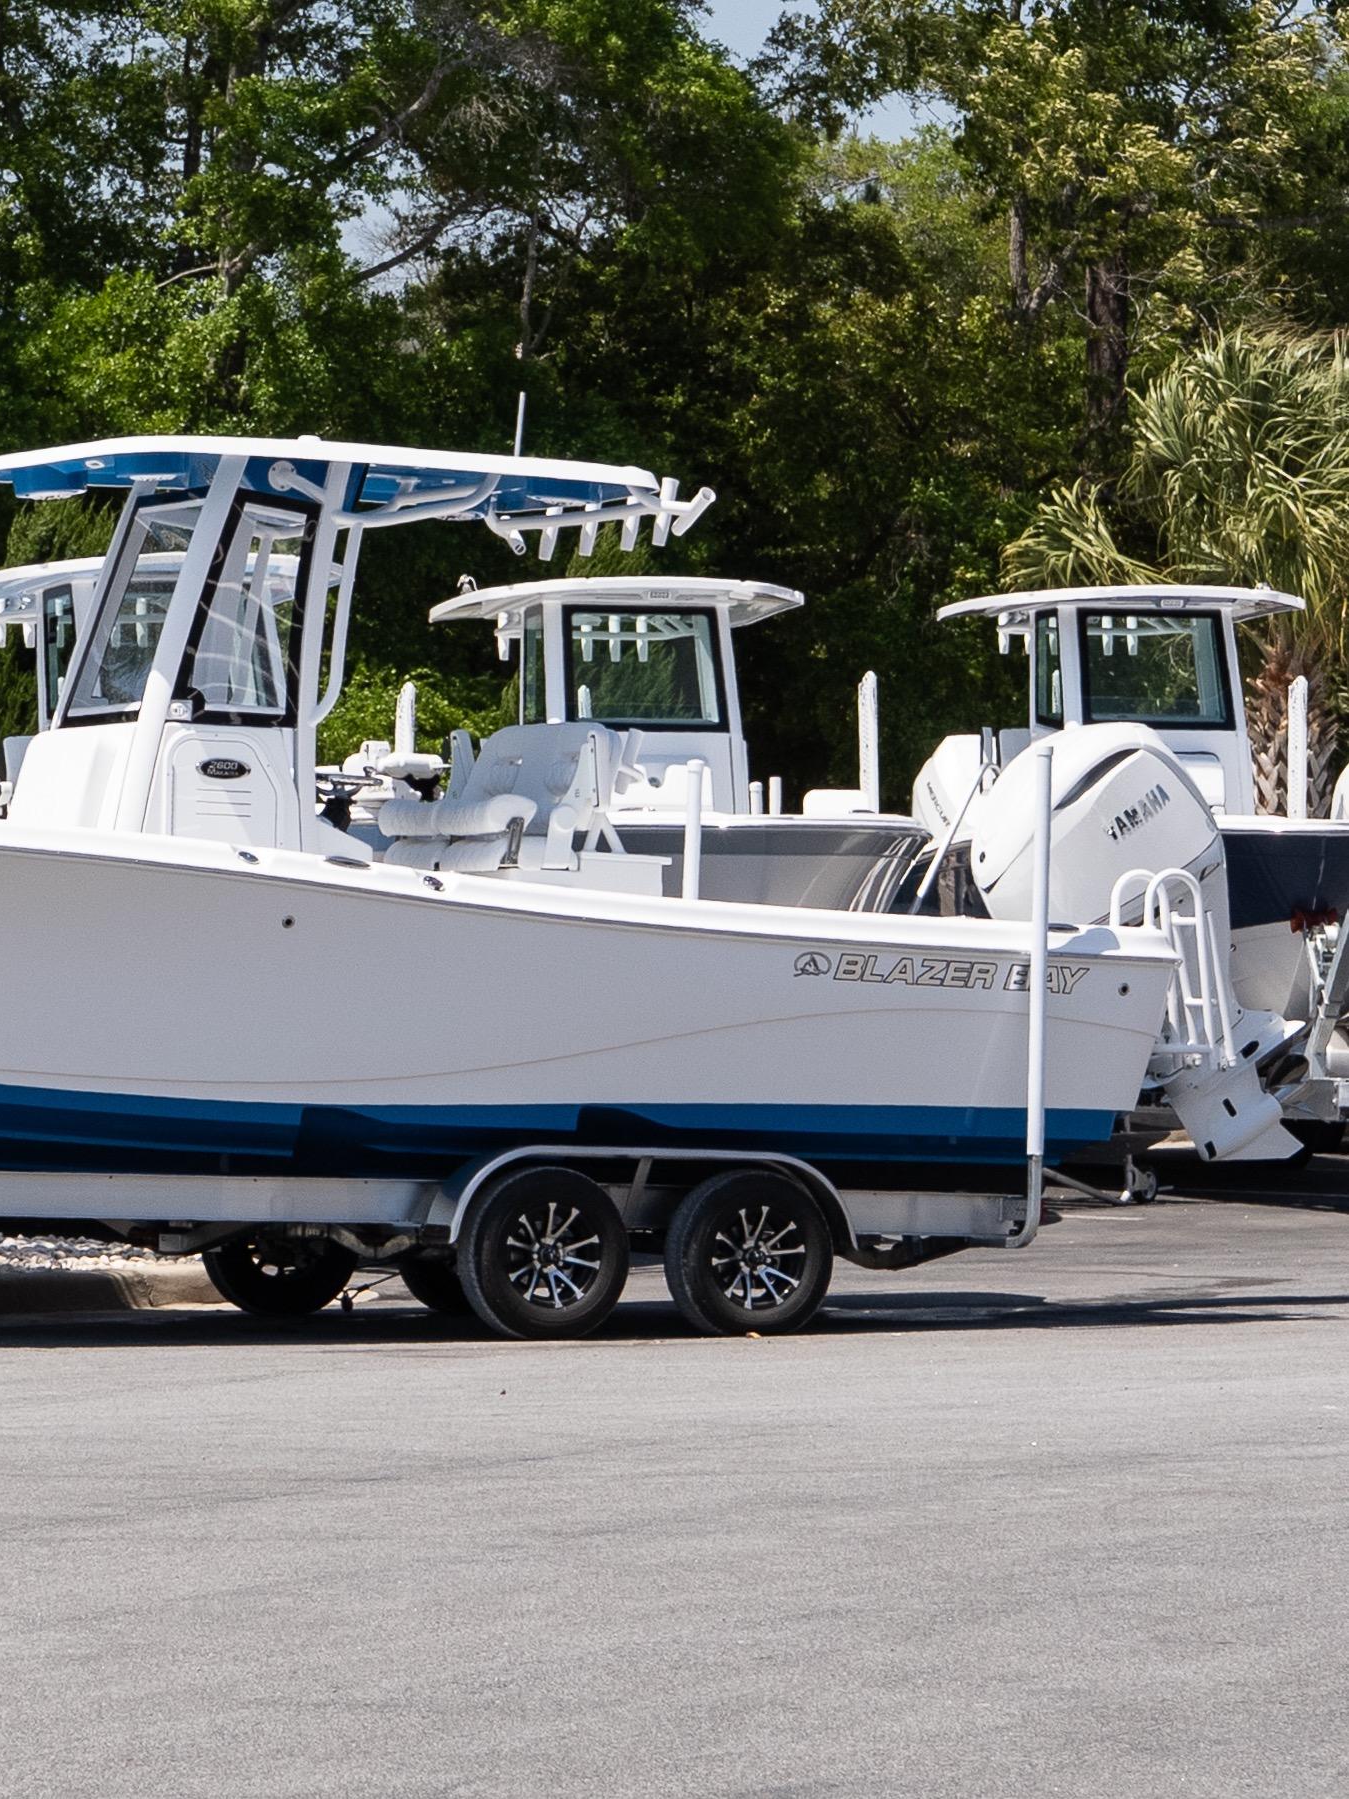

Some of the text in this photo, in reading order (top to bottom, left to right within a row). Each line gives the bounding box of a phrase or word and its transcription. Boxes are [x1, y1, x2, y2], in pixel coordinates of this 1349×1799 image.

[209, 761, 239, 770] 2600
[1104, 783, 1171, 844] YAMAHA
[833, 953, 998, 990] BLAZER
